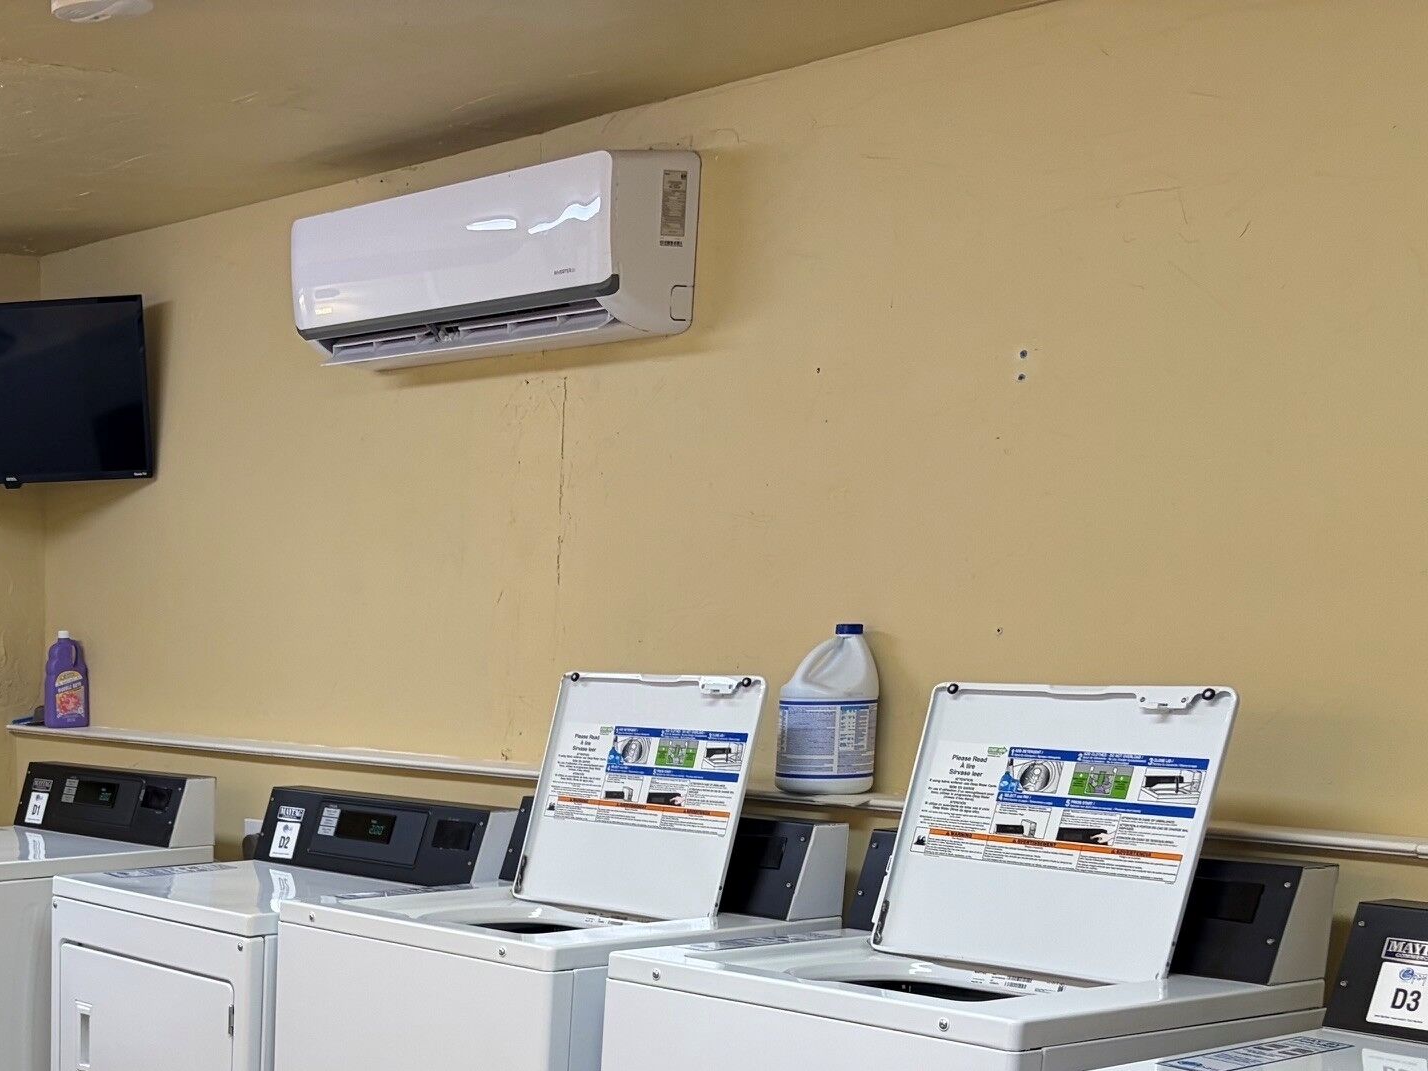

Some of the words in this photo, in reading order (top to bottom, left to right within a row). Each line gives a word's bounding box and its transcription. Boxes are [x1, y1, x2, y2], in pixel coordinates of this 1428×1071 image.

[32, 804, 41, 816] D1
[278, 836, 289, 849] D2
[1391, 988, 1422, 1012] D3
